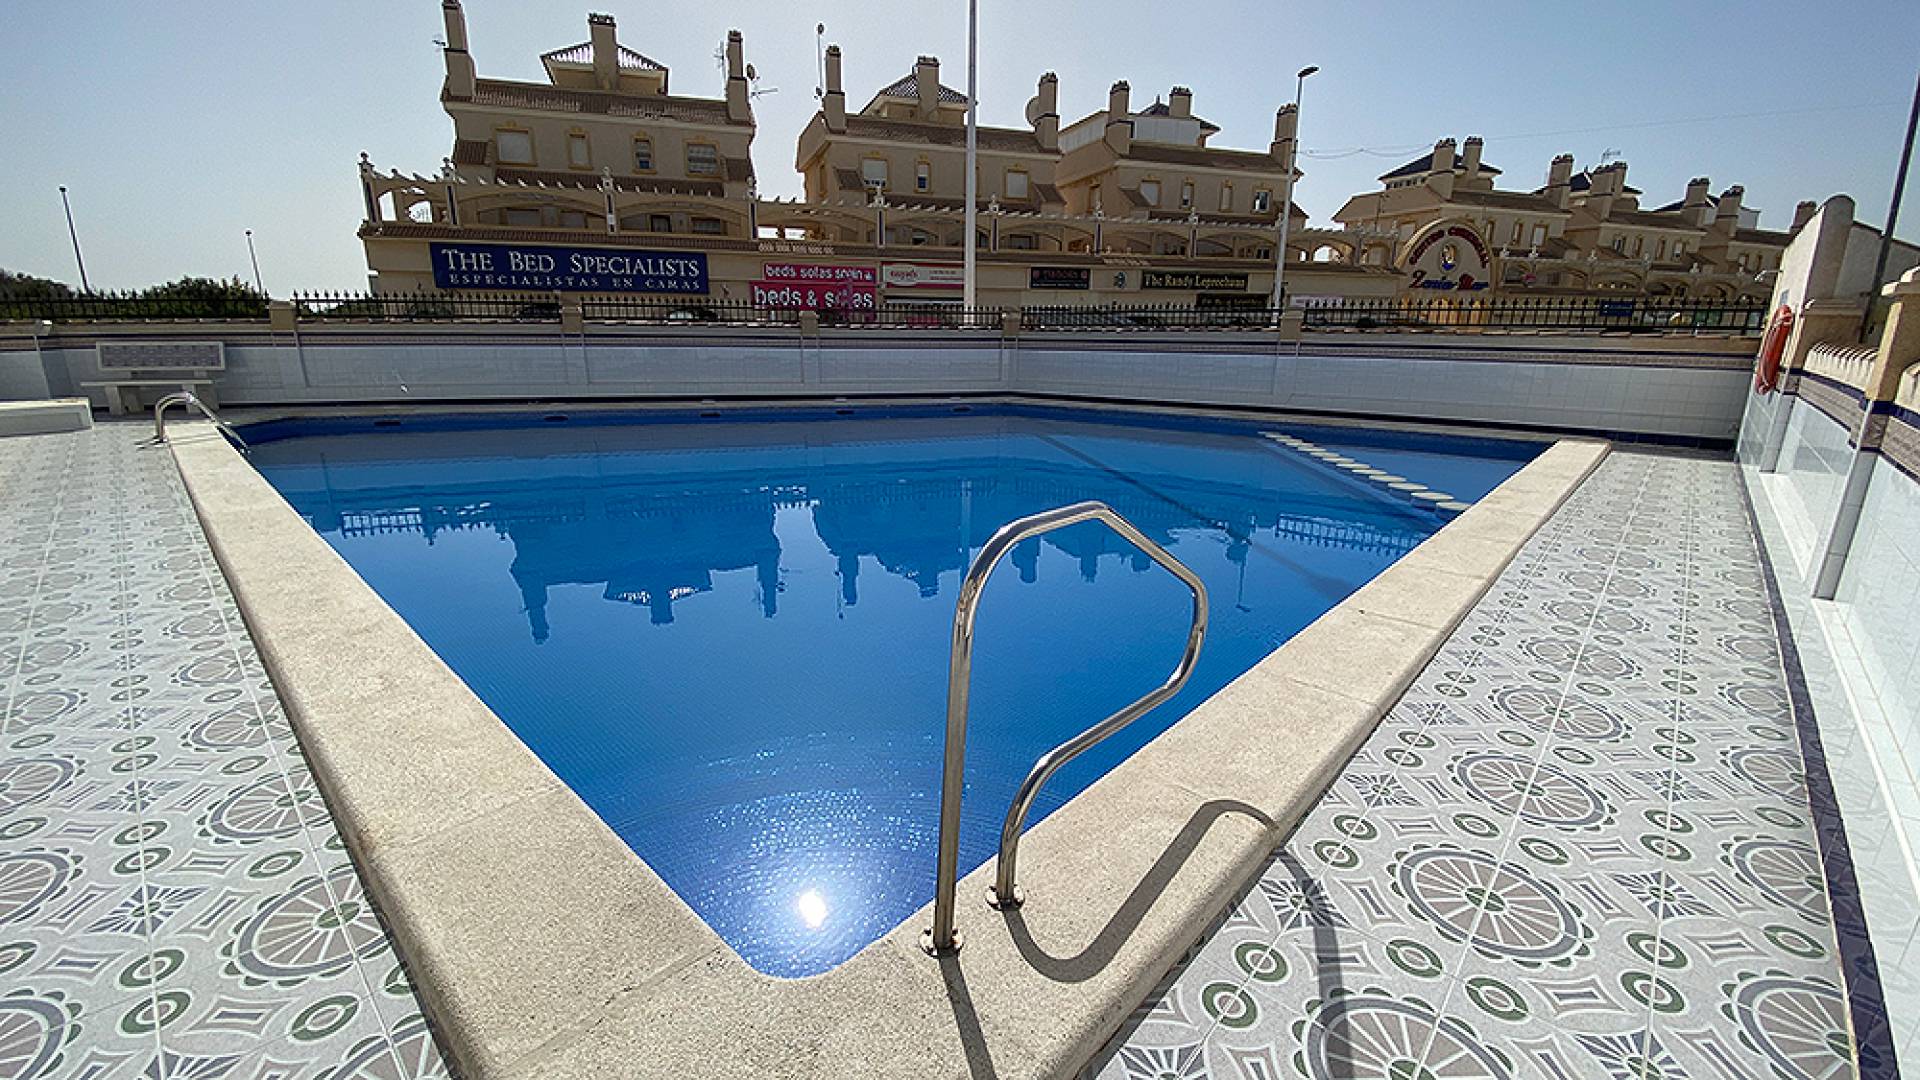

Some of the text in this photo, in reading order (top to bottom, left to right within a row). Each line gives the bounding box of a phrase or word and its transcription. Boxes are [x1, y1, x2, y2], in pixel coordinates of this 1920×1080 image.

[441, 249, 700, 277] THE BED SPECIALISTS
[449, 274, 700, 290] ESPECIALISTAS EN CAMAS
[1143, 273, 1162, 287] The
[754, 285, 873, 308] beds & sas
